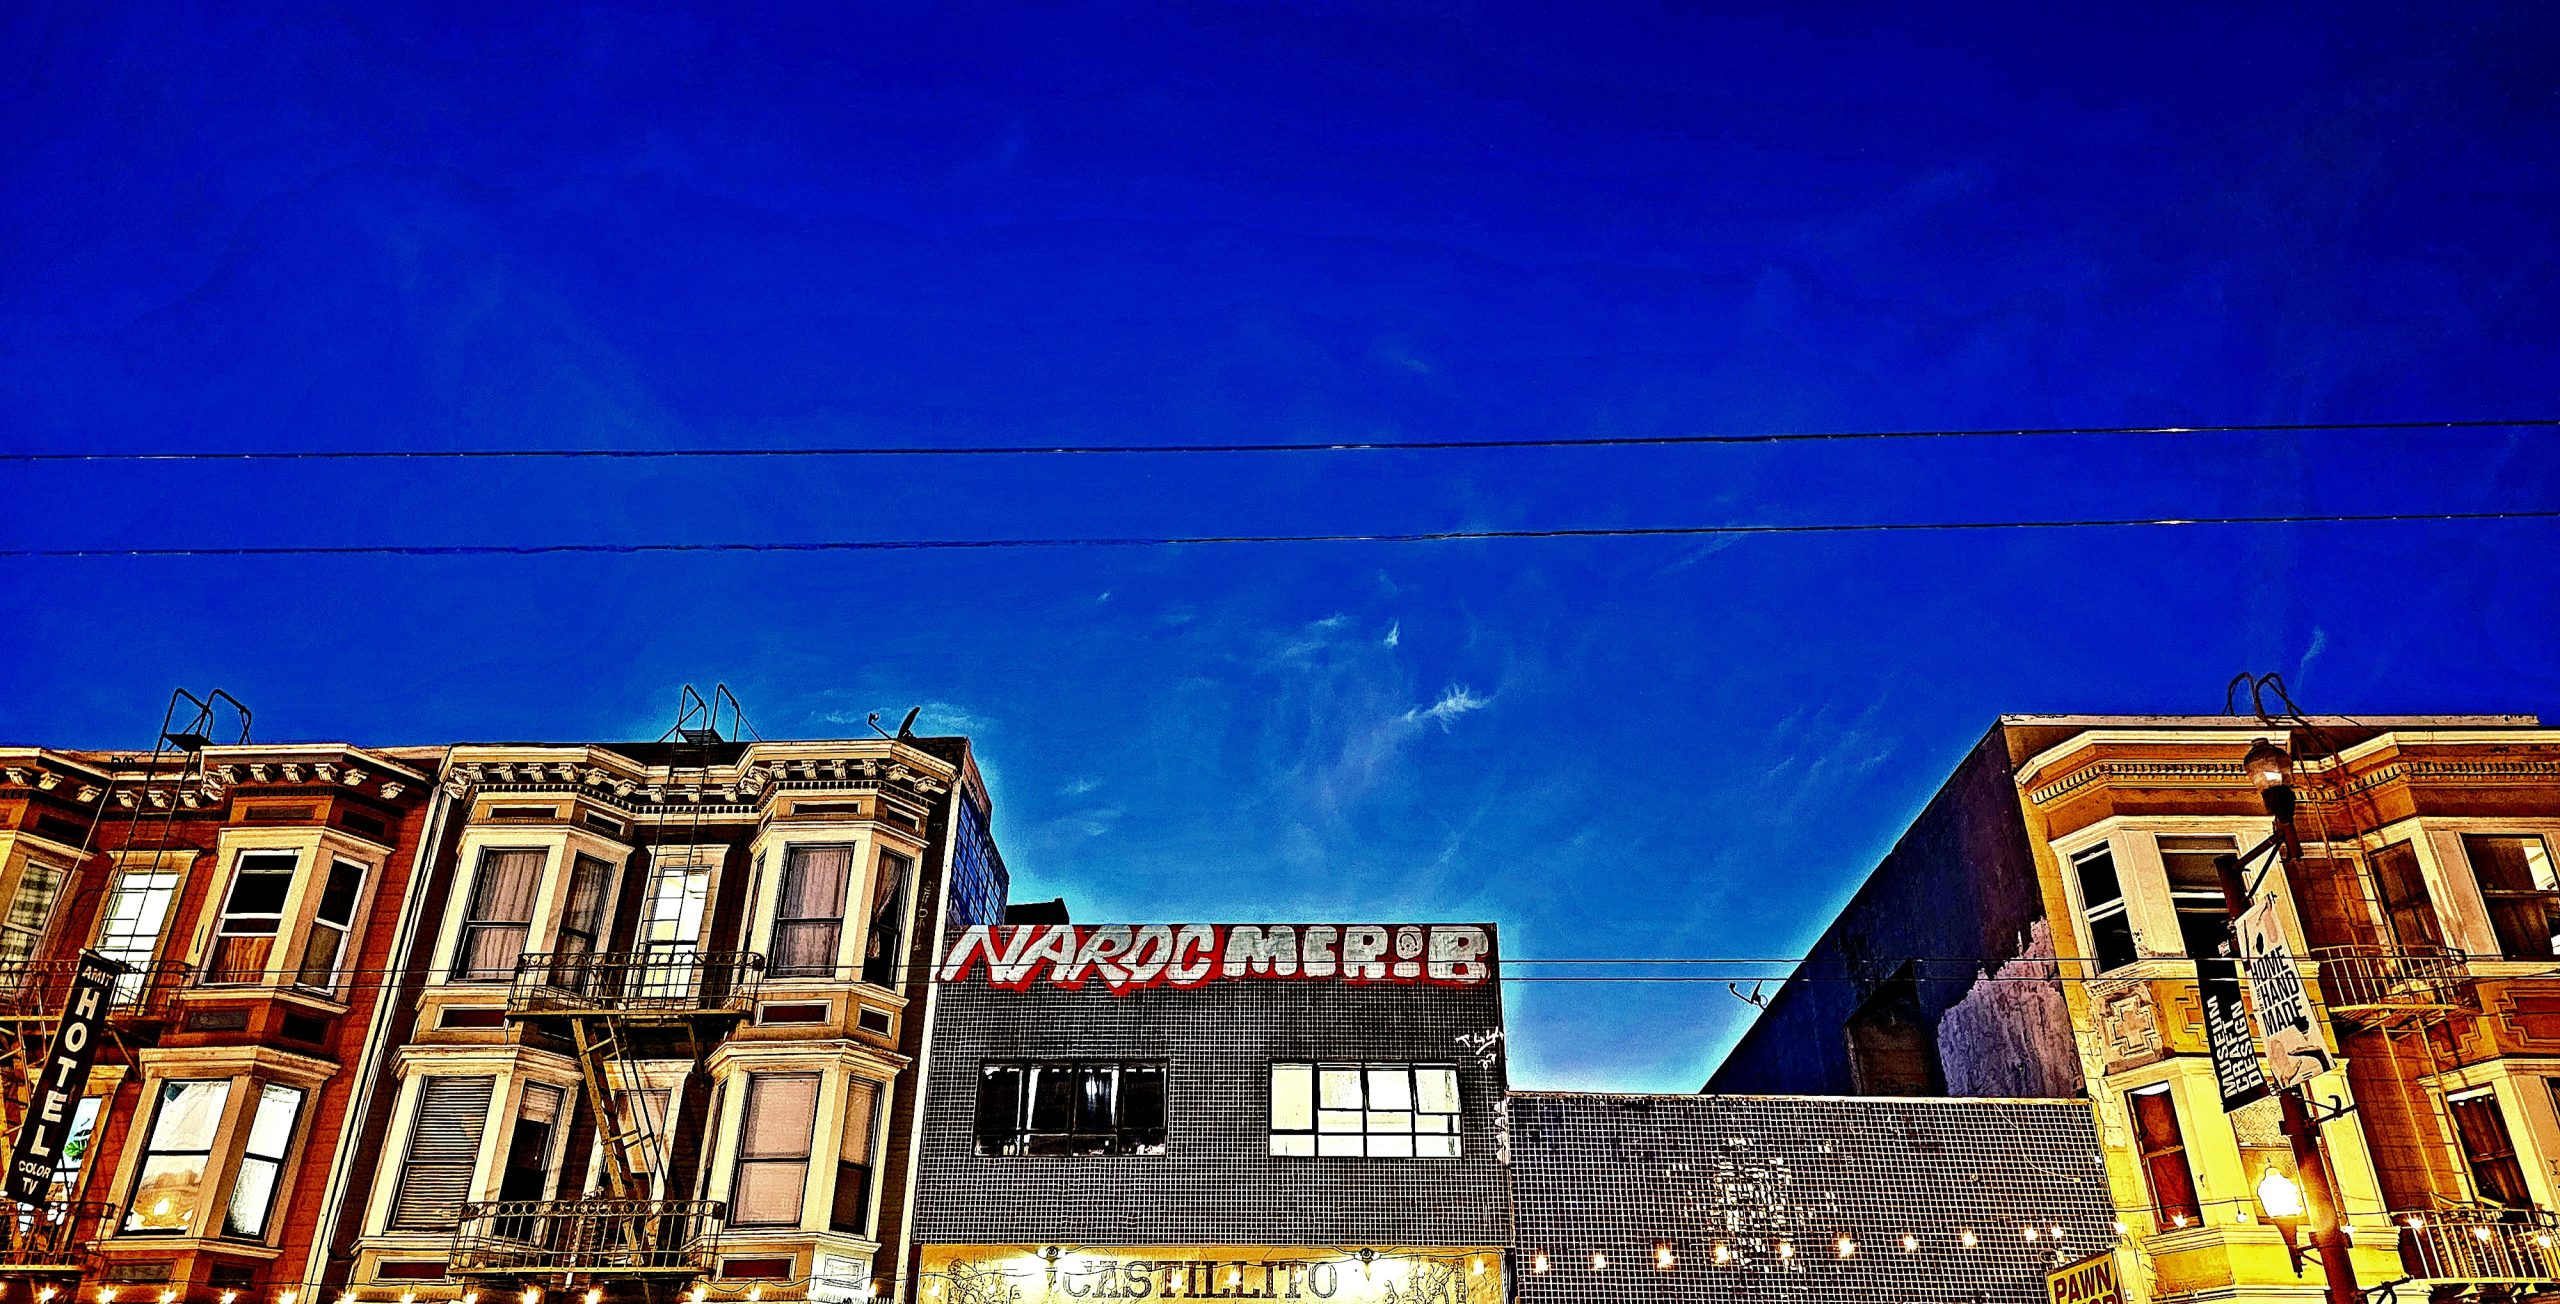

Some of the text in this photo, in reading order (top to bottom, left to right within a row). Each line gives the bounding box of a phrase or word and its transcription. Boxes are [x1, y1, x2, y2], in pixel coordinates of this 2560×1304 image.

[82, 965, 113, 986] AMIT
[2252, 945, 2289, 987] HOME
[2260, 970, 2299, 1009] HAND
[2261, 996, 2302, 1037] MADE
[2207, 995, 2237, 1098] MUSEUM
[2223, 1019, 2250, 1092] CRAFT
[2230, 1000, 2263, 1087] DESIGN
[30, 987, 100, 1157] HOTEL
[18, 1160, 51, 1179] COLOR
[22, 1177, 38, 1195] TV
[1063, 1260, 1338, 1298] CASTILLITO
[2053, 1261, 2113, 1304] PAWN
